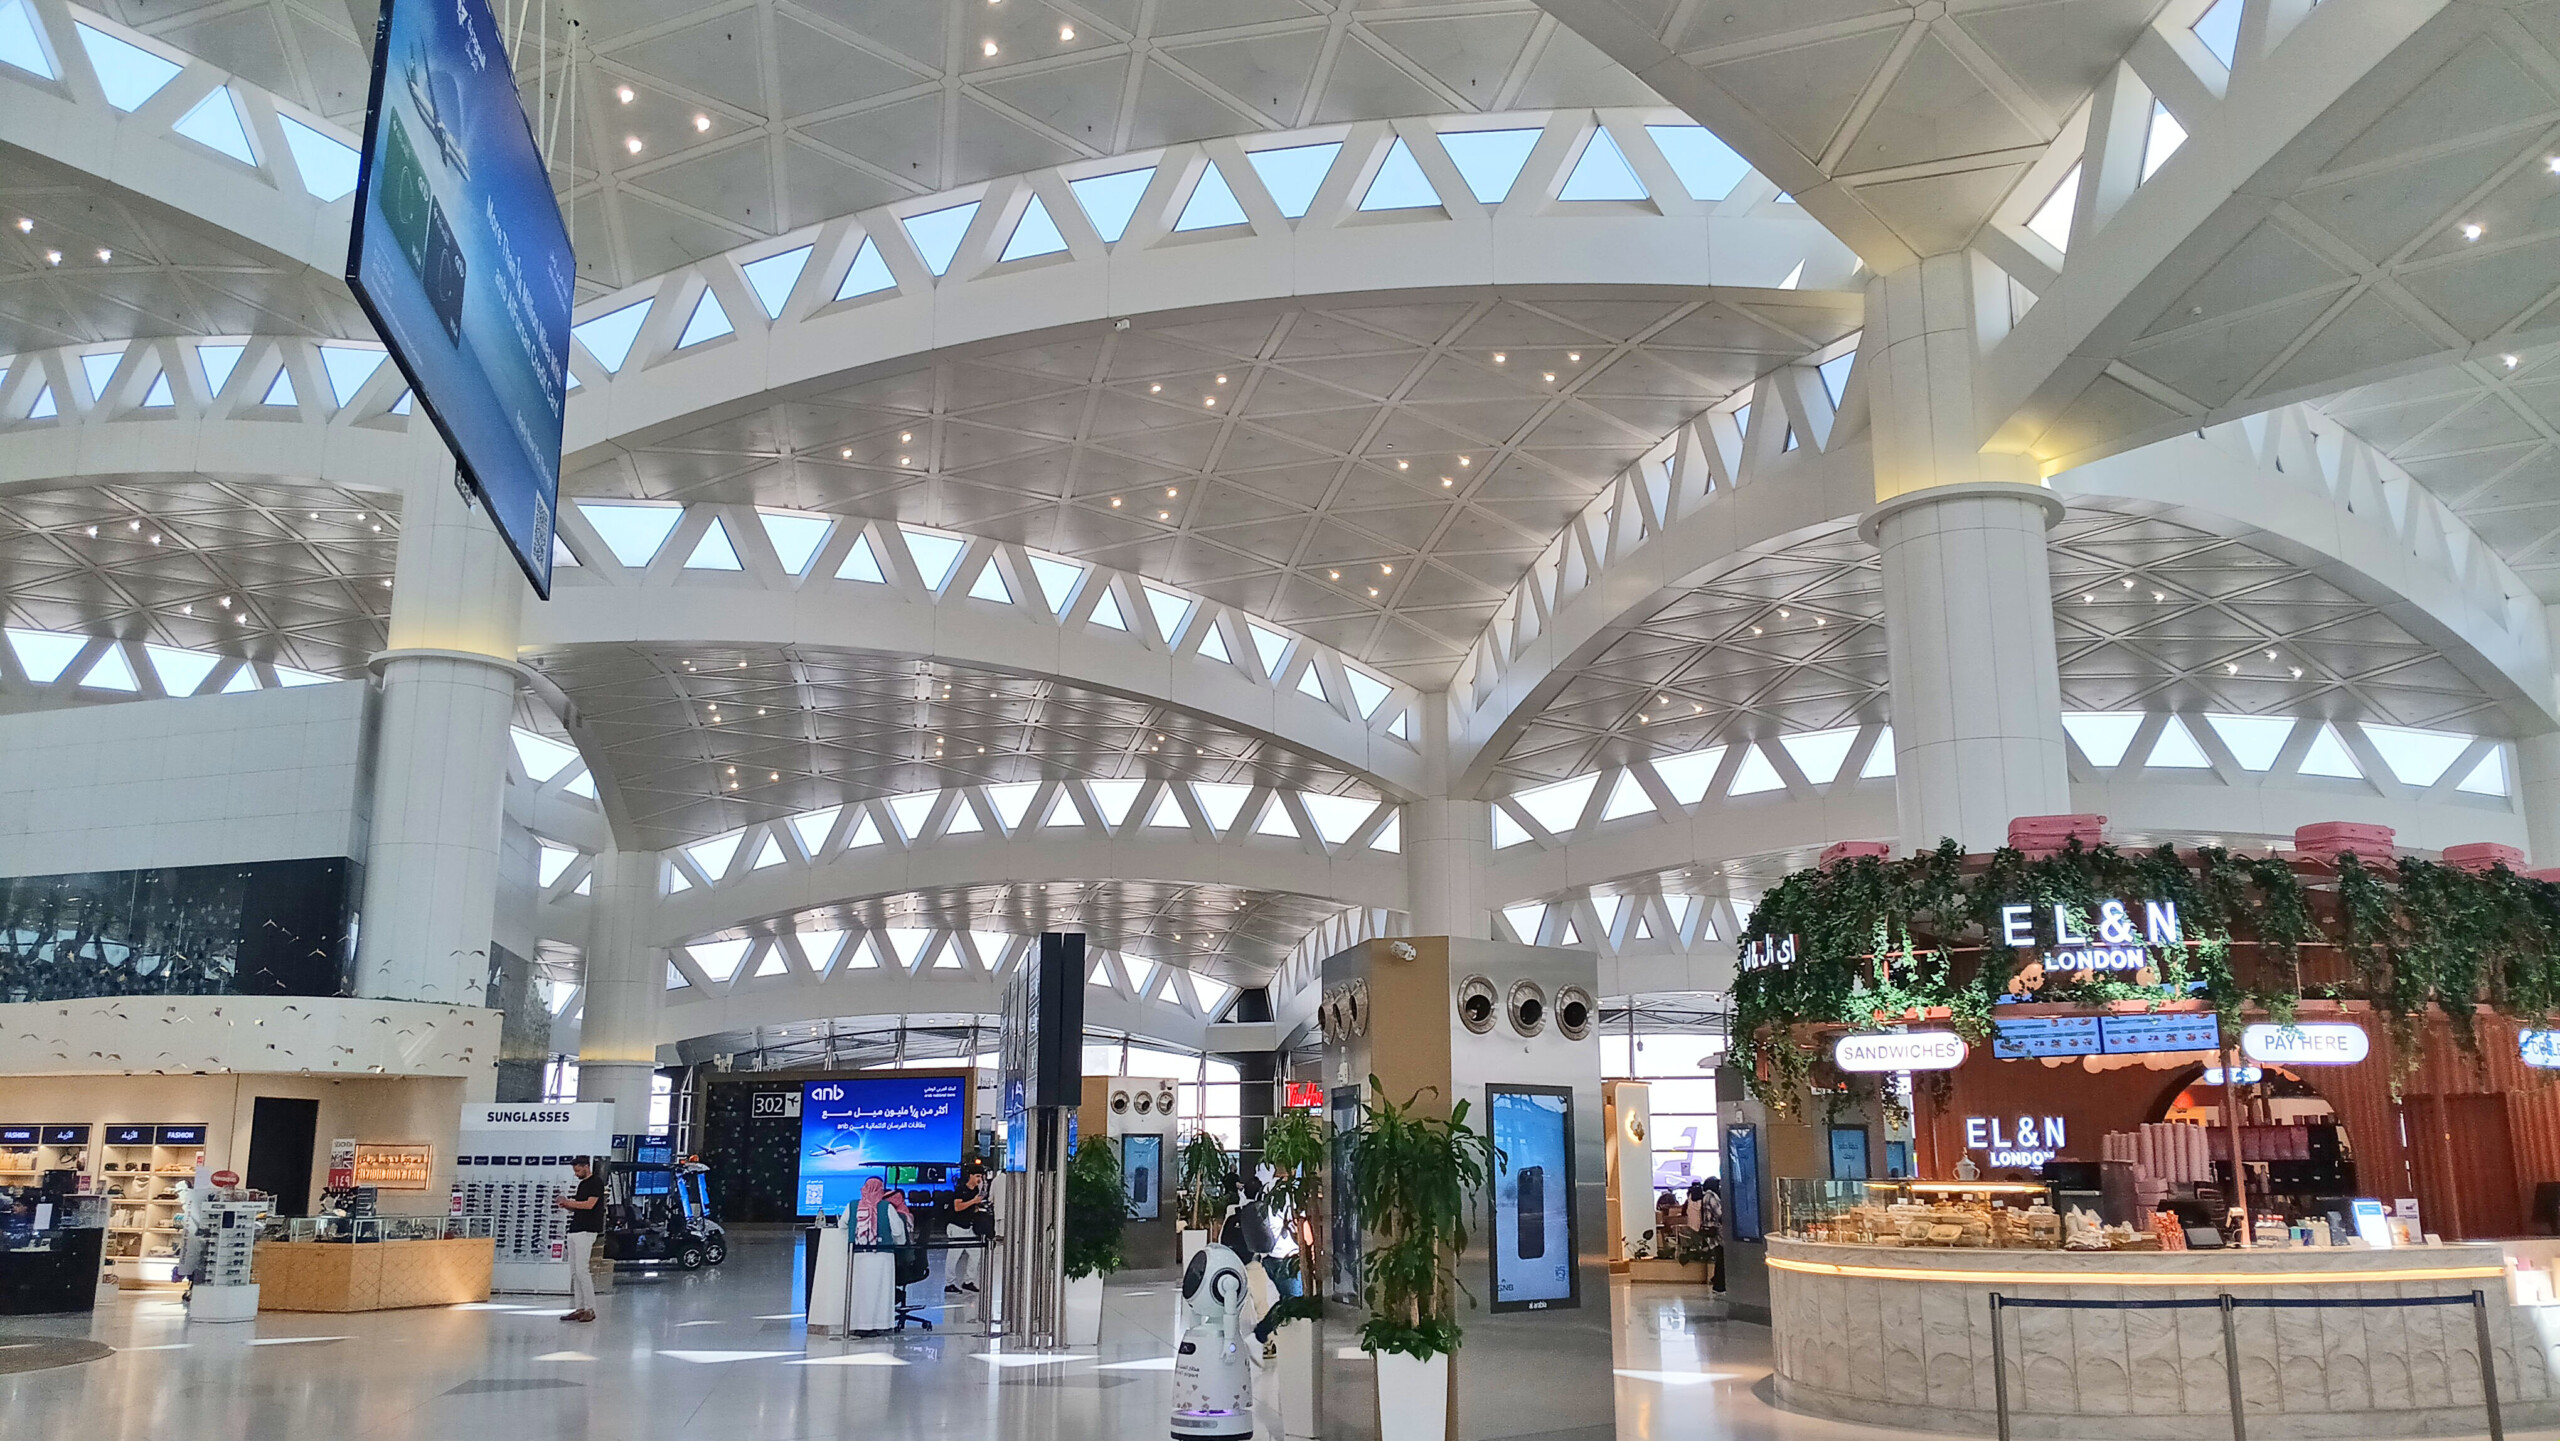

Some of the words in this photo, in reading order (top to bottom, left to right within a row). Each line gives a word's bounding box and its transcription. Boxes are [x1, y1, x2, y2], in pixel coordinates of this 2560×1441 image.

[486, 194, 502, 248] More
[502, 230, 516, 281] Than
[522, 280, 539, 336] Million
[538, 319, 551, 364] Miles
[530, 342, 548, 395] Credit
[546, 380, 560, 420] Card
[2044, 949, 2146, 971] LONDON
[2265, 1034, 2295, 1050] PAY
[2301, 1035, 2348, 1051] HERE
[1844, 1043, 1956, 1060] SANDWICHES
[811, 1083, 845, 1101] anb
[754, 1097, 783, 1114] 302
[884, 1105, 909, 1119] مليون
[920, 1107, 934, 1119] من
[934, 1103, 949, 1117] أكثر
[487, 1111, 570, 1123] SUNGLASSES
[4, 1131, 30, 1139] FASHION
[167, 1131, 194, 1139] FASHION
[1966, 1115, 2066, 1149] EL&N
